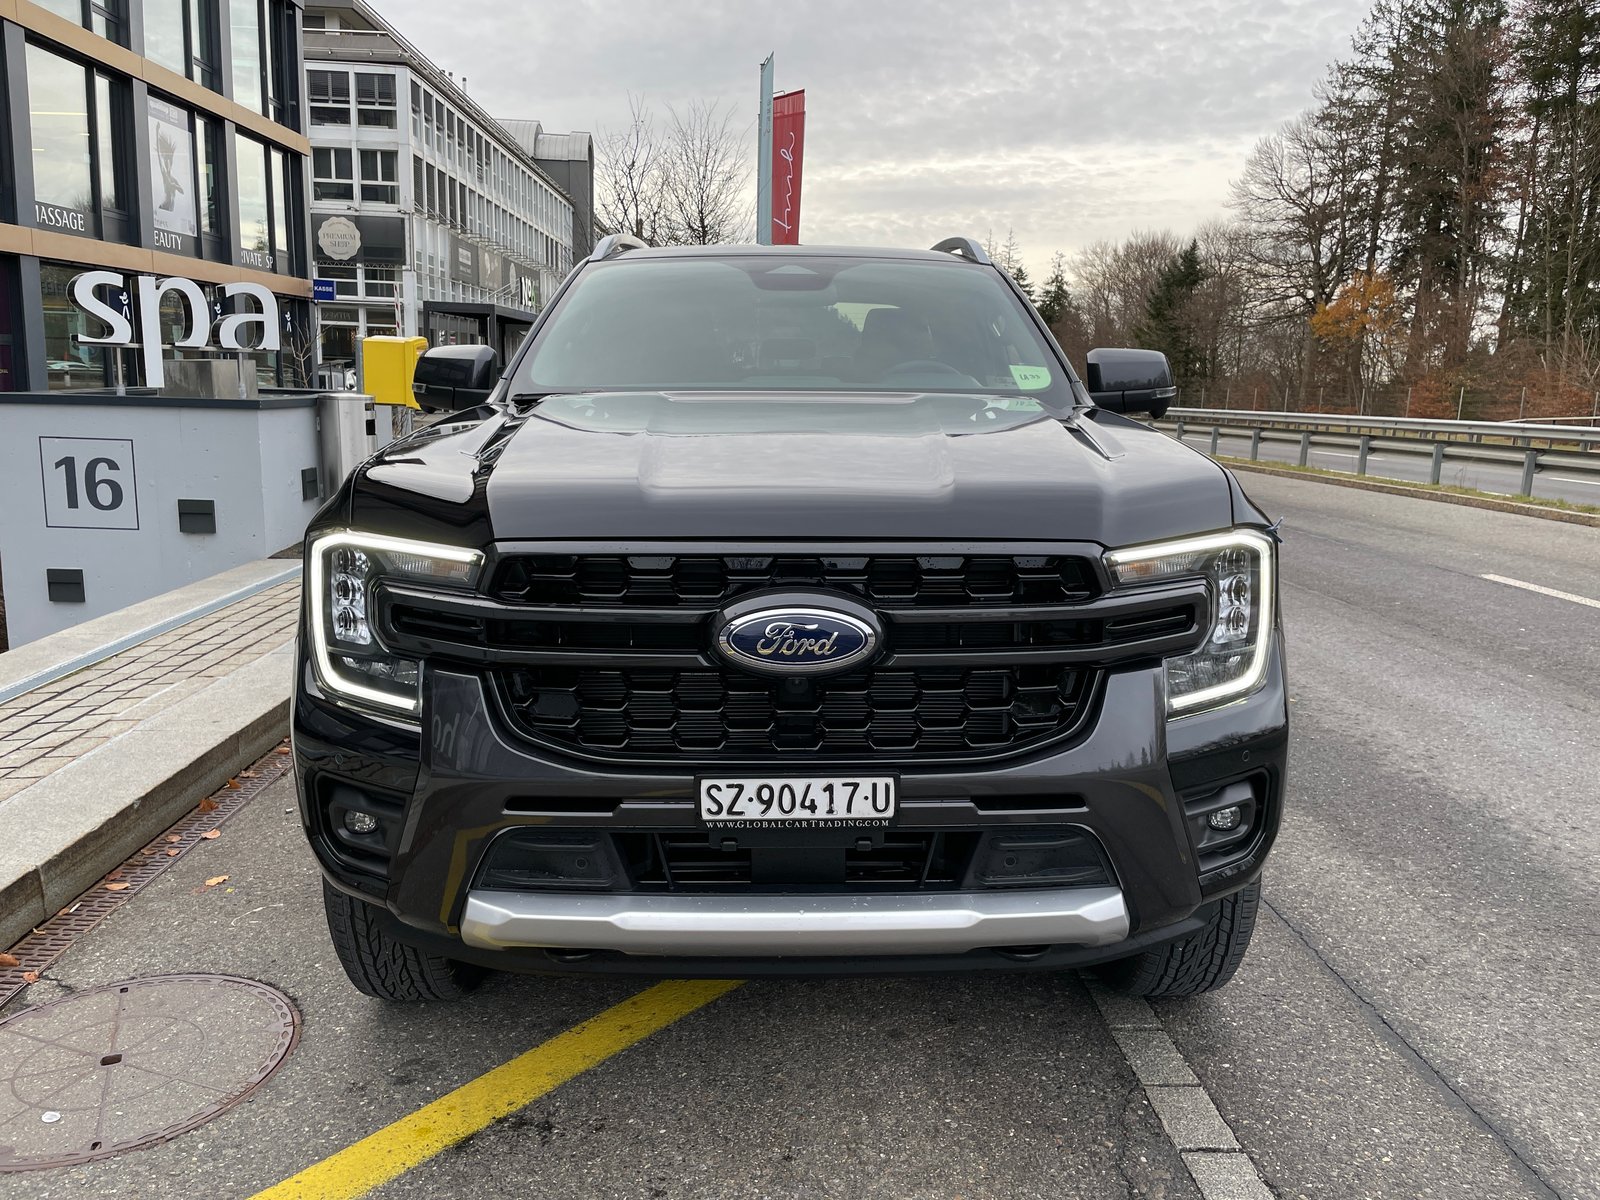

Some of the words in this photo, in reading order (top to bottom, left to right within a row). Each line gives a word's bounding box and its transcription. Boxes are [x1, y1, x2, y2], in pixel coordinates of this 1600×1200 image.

[322, 233, 356, 241] PREMIUM
[314, 285, 334, 293] KASSE
[73, 270, 280, 389] spa
[54, 456, 124, 511] 16
[756, 621, 839, 656] Ford
